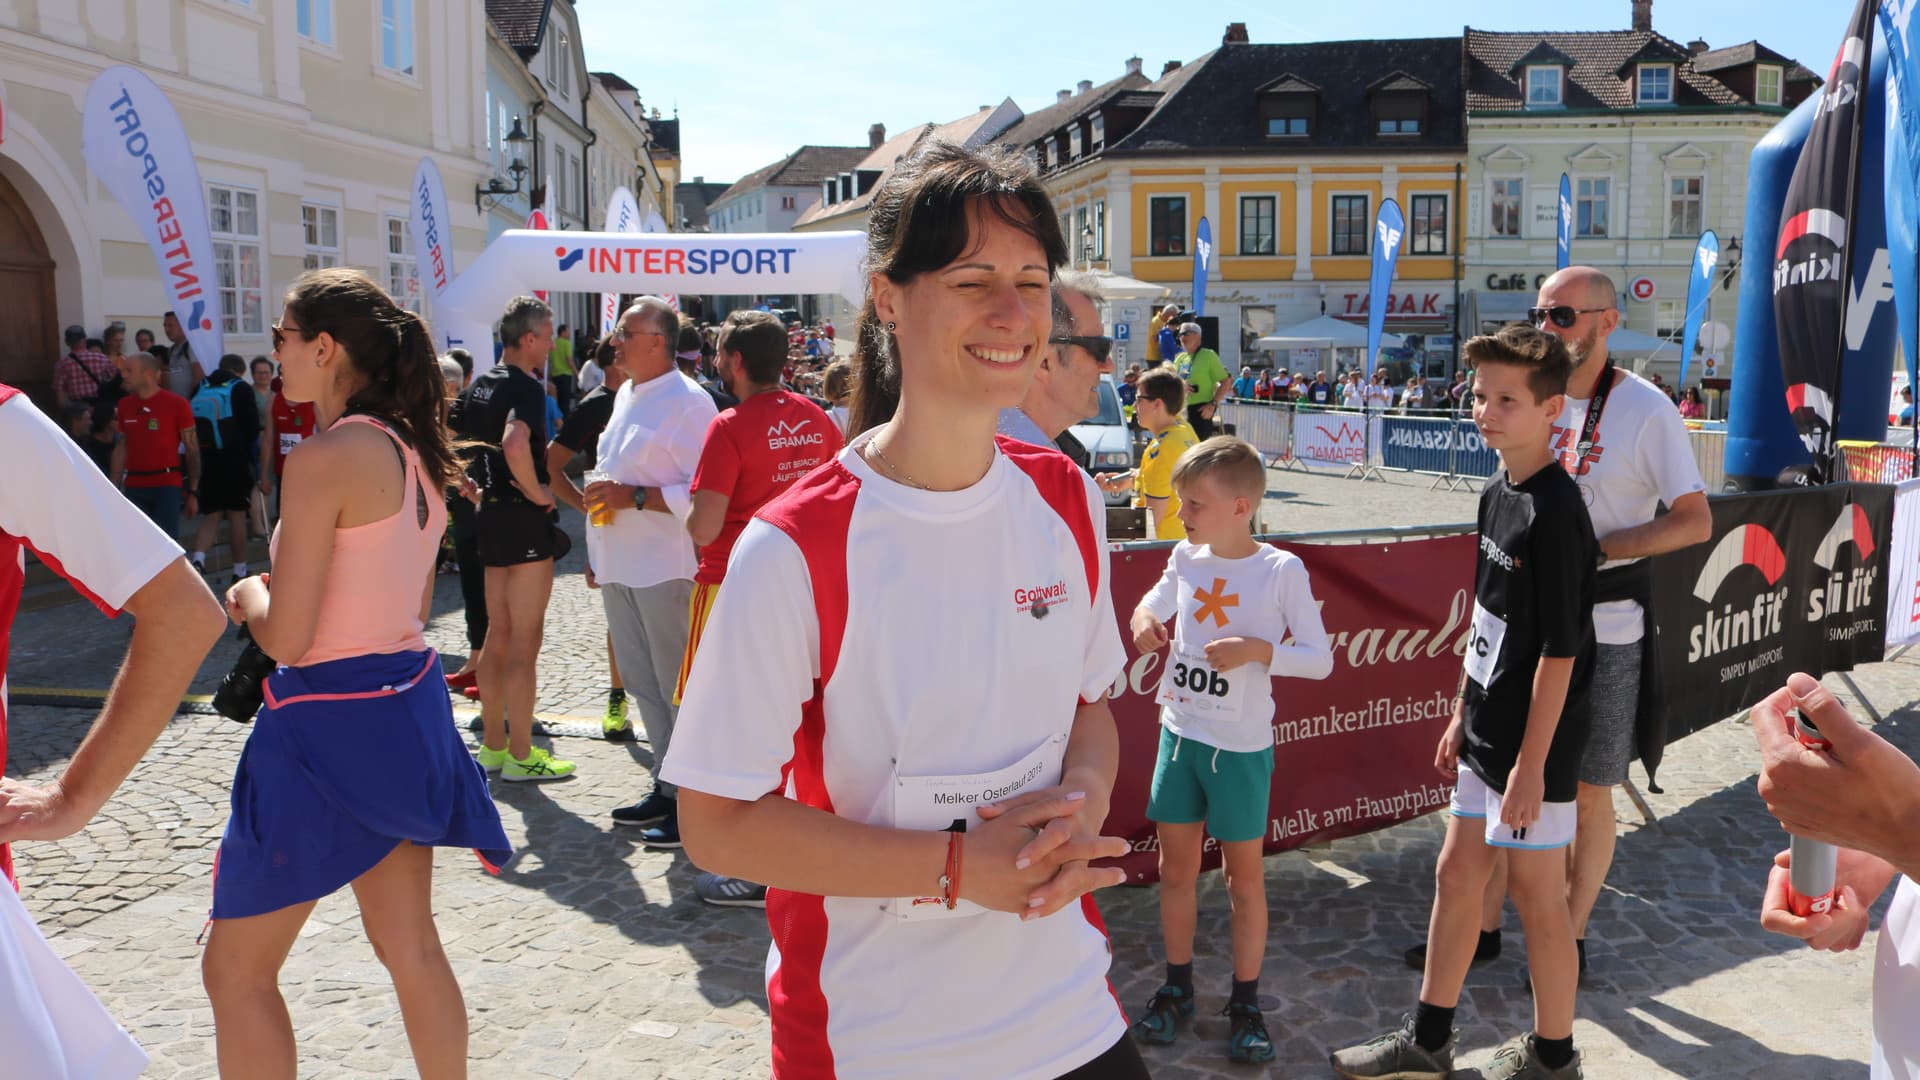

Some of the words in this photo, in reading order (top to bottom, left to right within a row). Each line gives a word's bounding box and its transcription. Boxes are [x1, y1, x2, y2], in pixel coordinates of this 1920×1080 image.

[588, 247, 797, 275] INTERSPORT
[1486, 273, 1526, 291] Café
[1117, 324, 1128, 337] P
[768, 432, 824, 450] BRAMAC
[1173, 662, 1229, 697] 30b
[1720, 660, 1746, 683] SIMPLY
[934, 793, 979, 805] Melker
[982, 774, 1026, 801] Osterlauf
[1027, 761, 1043, 783] 2019
[1272, 808, 1320, 842] Melk
[1323, 805, 1353, 828] am
